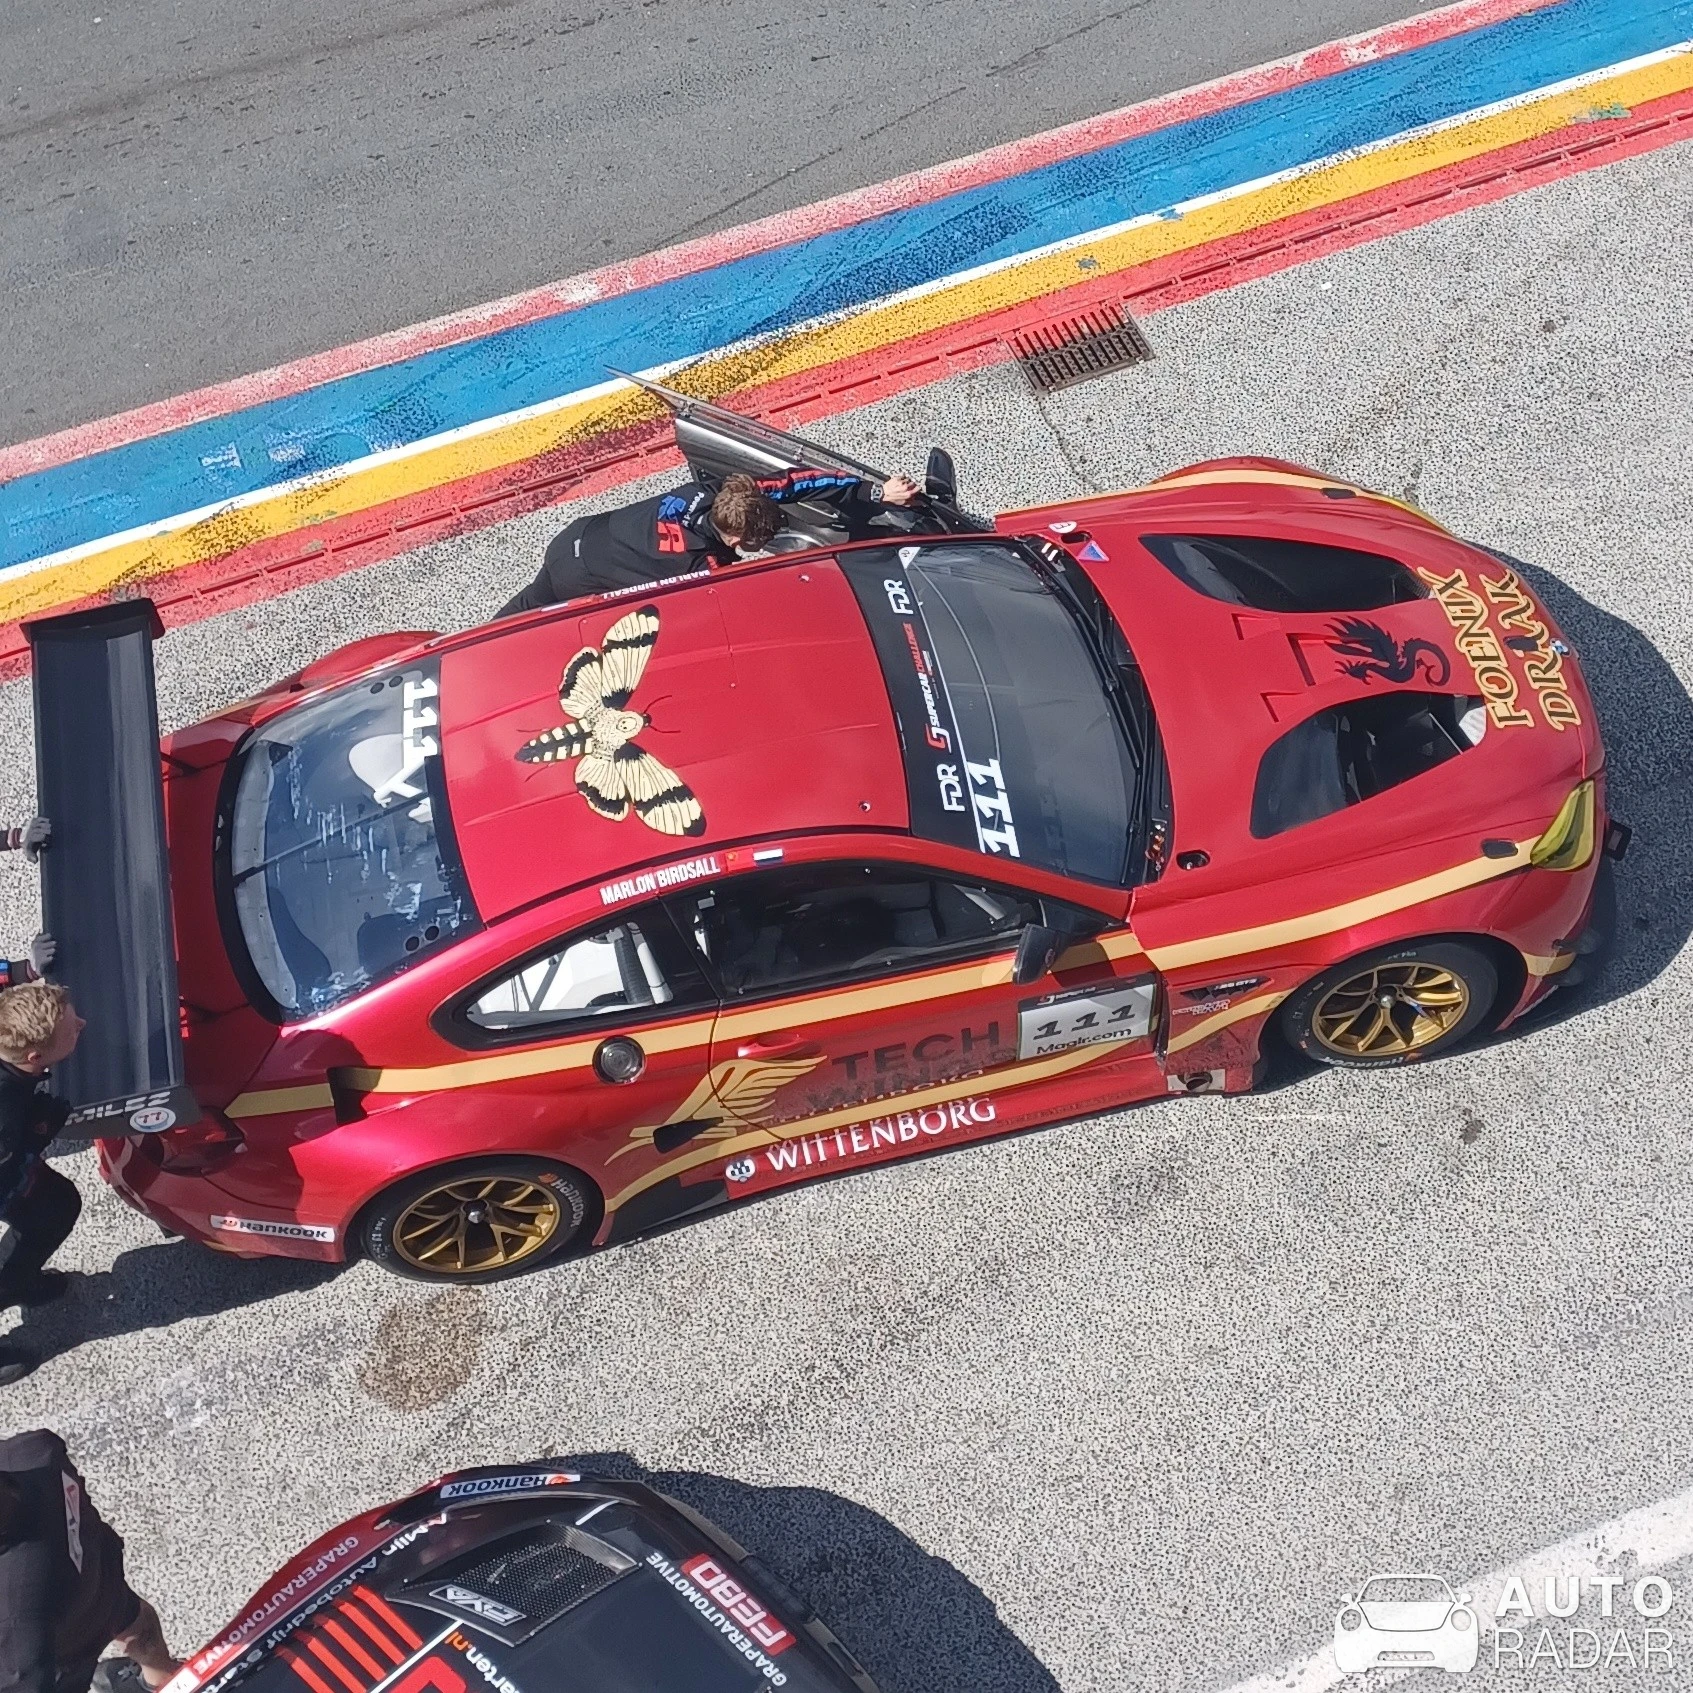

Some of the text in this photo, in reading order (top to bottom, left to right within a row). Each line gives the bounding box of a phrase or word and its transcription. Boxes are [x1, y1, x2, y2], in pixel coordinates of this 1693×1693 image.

[883, 578, 914, 615] FDR
[1417, 566, 1535, 729] FOENIX
[403, 678, 438, 768] 111
[936, 763, 966, 812] FDR
[966, 758, 1021, 858] 111
[600, 856, 721, 905] MARLON BIRDSALL
[831, 1021, 1000, 1080] TECH
[766, 1096, 997, 1172] WITTENBORG
[645, 1552, 788, 1687] GRAPERAUTOMOTIVE
[689, 1560, 788, 1648] FEBO
[444, 1631, 520, 1693] arten.nl
